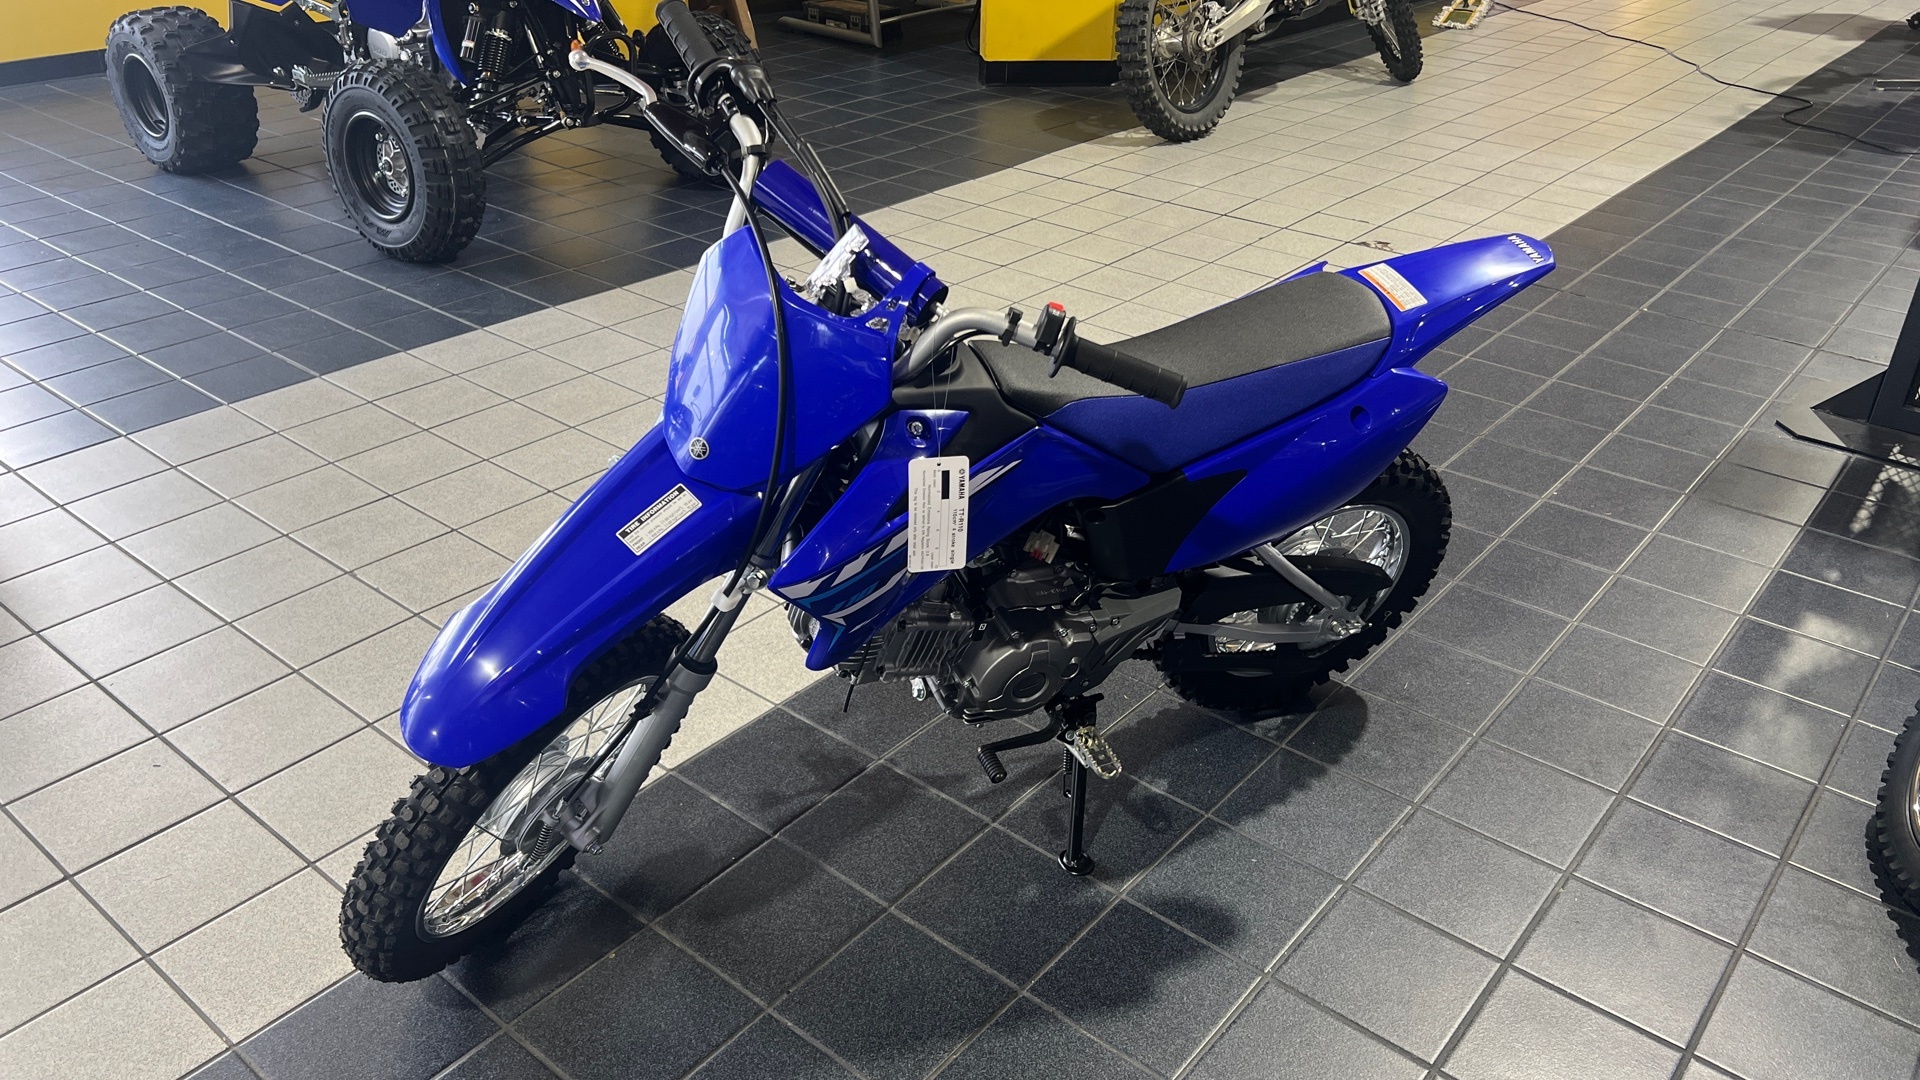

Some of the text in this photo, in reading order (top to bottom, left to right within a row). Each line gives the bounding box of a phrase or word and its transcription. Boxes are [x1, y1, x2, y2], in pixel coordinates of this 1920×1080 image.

[1507, 235, 1545, 264] YAMAHA
[625, 520, 640, 533] TIRE
[640, 490, 679, 521] INFORMATION
